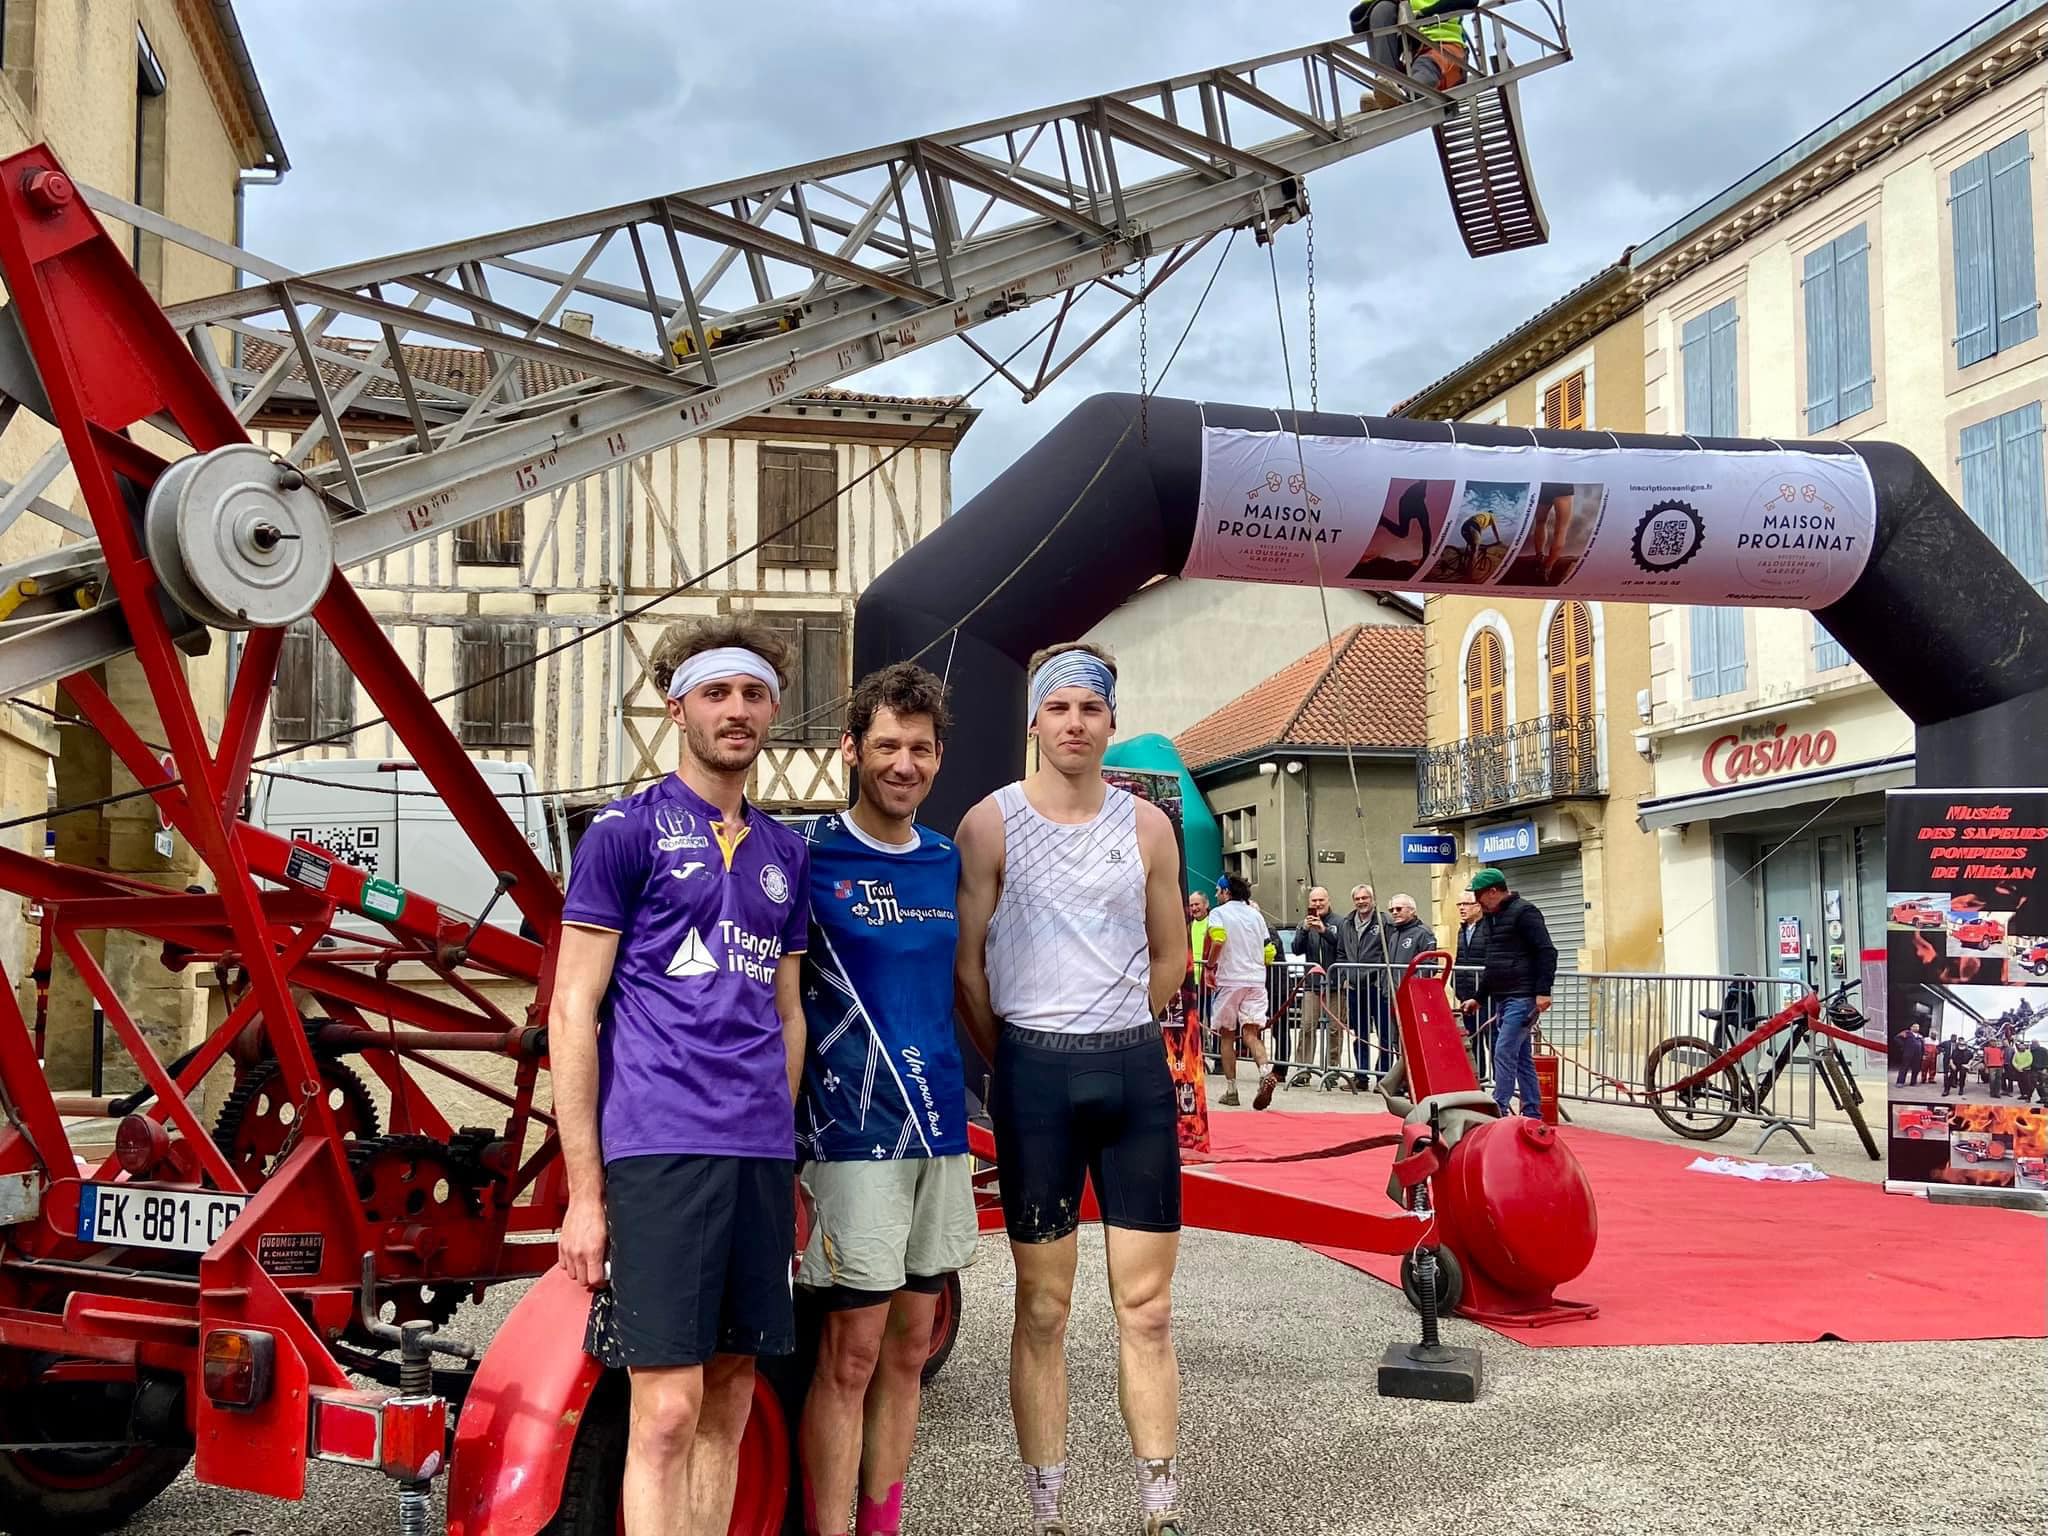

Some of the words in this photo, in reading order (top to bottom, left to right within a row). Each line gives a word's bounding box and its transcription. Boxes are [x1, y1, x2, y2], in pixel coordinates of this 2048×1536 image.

[1244, 503, 1321, 524] MAISON
[1763, 515, 1836, 531] MAISON
[1217, 520, 1343, 544] PROLAINAT
[1737, 533, 1856, 552] PROLAINAT
[1703, 723, 1837, 789] Casino
[1918, 827, 1957, 840] DES
[1961, 827, 2048, 840] SAPEURS
[1408, 843, 1438, 853] Allianz
[1484, 835, 1516, 853] Allianz
[1930, 847, 2028, 860] POMPIERS
[1931, 866, 1959, 879] DE
[857, 879, 894, 904] Trail
[1041, 1033, 1097, 1050] NIKE
[1101, 1026, 1139, 1048] PRO
[927, 1110, 943, 1137] tous
